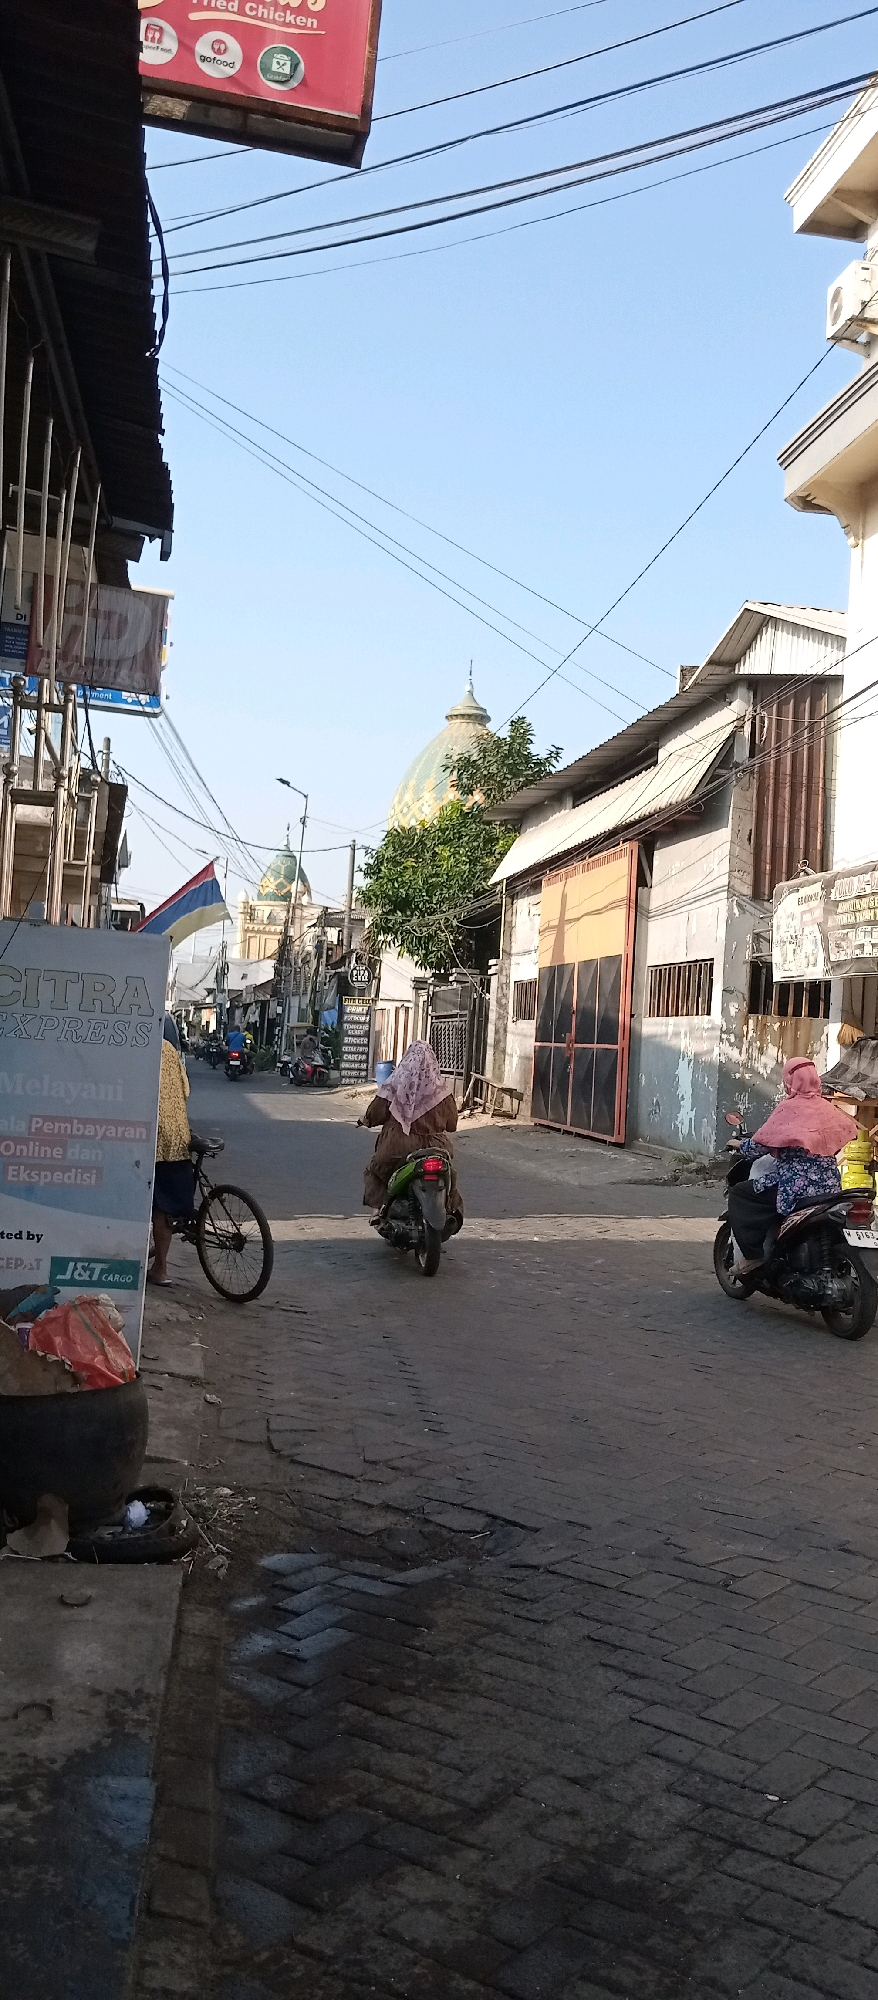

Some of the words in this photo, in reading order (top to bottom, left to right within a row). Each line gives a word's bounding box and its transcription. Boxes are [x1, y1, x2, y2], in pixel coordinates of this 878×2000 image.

[245, 3, 318, 29] Chicken
[199, 53, 236, 70] gofood
[16, 613, 27, 622] DI
[77, 690, 113, 700] pyment
[0, 964, 155, 1017] CITRA
[347, 1006, 368, 1014] PRINT
[343, 1037, 368, 1045] STICKER
[0, 1071, 124, 1105] Melayani
[31, 1117, 147, 1140] Pembayaran
[0, 1140, 64, 1159] Online
[66, 1143, 103, 1161] dan
[7, 1165, 97, 1186] Ekspedisi
[26, 1231, 44, 1243] by
[55, 1261, 112, 1281] J&T
[102, 1273, 134, 1284] CARGO
